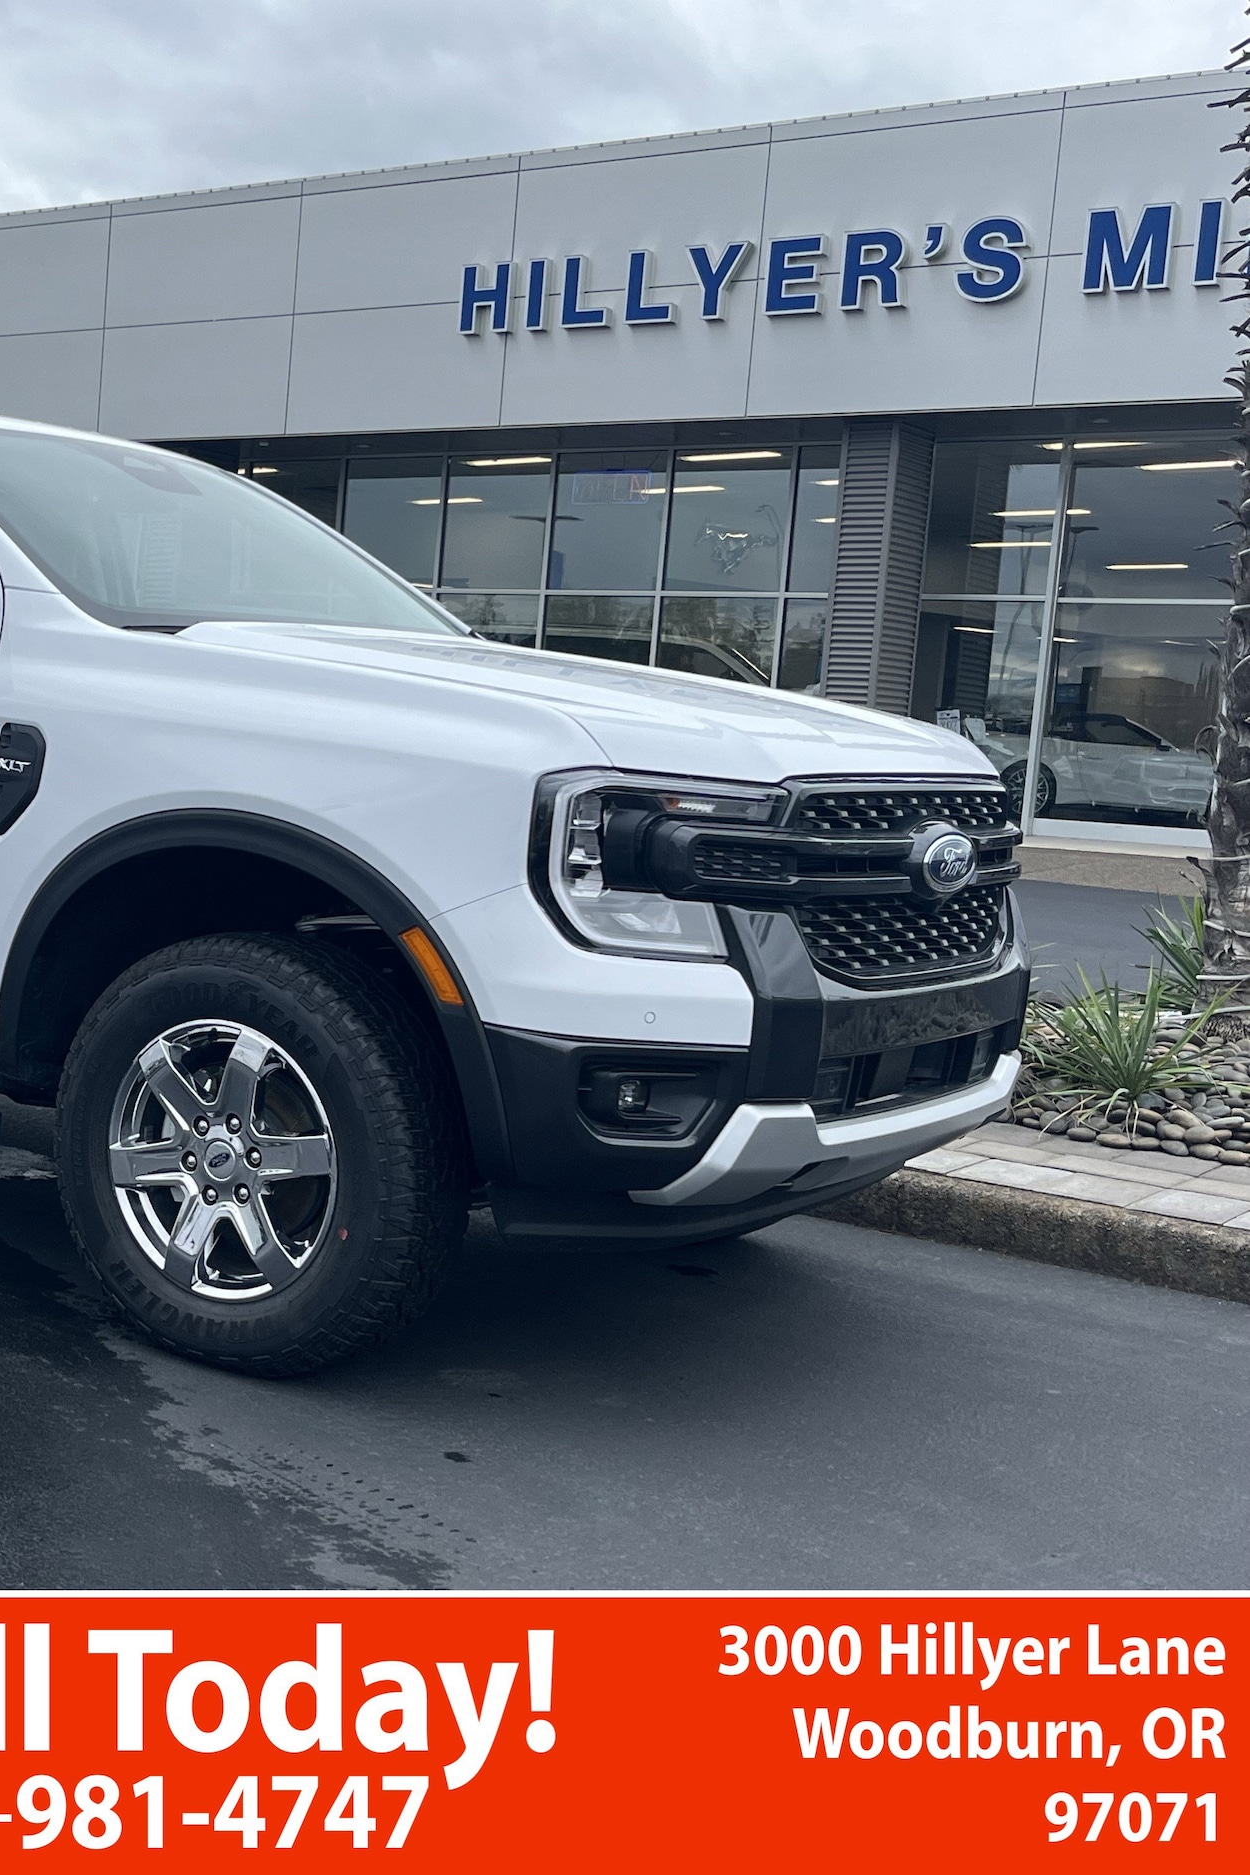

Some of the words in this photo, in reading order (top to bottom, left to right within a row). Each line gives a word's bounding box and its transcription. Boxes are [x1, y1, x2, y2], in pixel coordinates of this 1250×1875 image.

[458, 214, 1031, 335] HILLYER'S
[1081, 198, 1250, 292] MI
[939, 847, 969, 878] Ford
